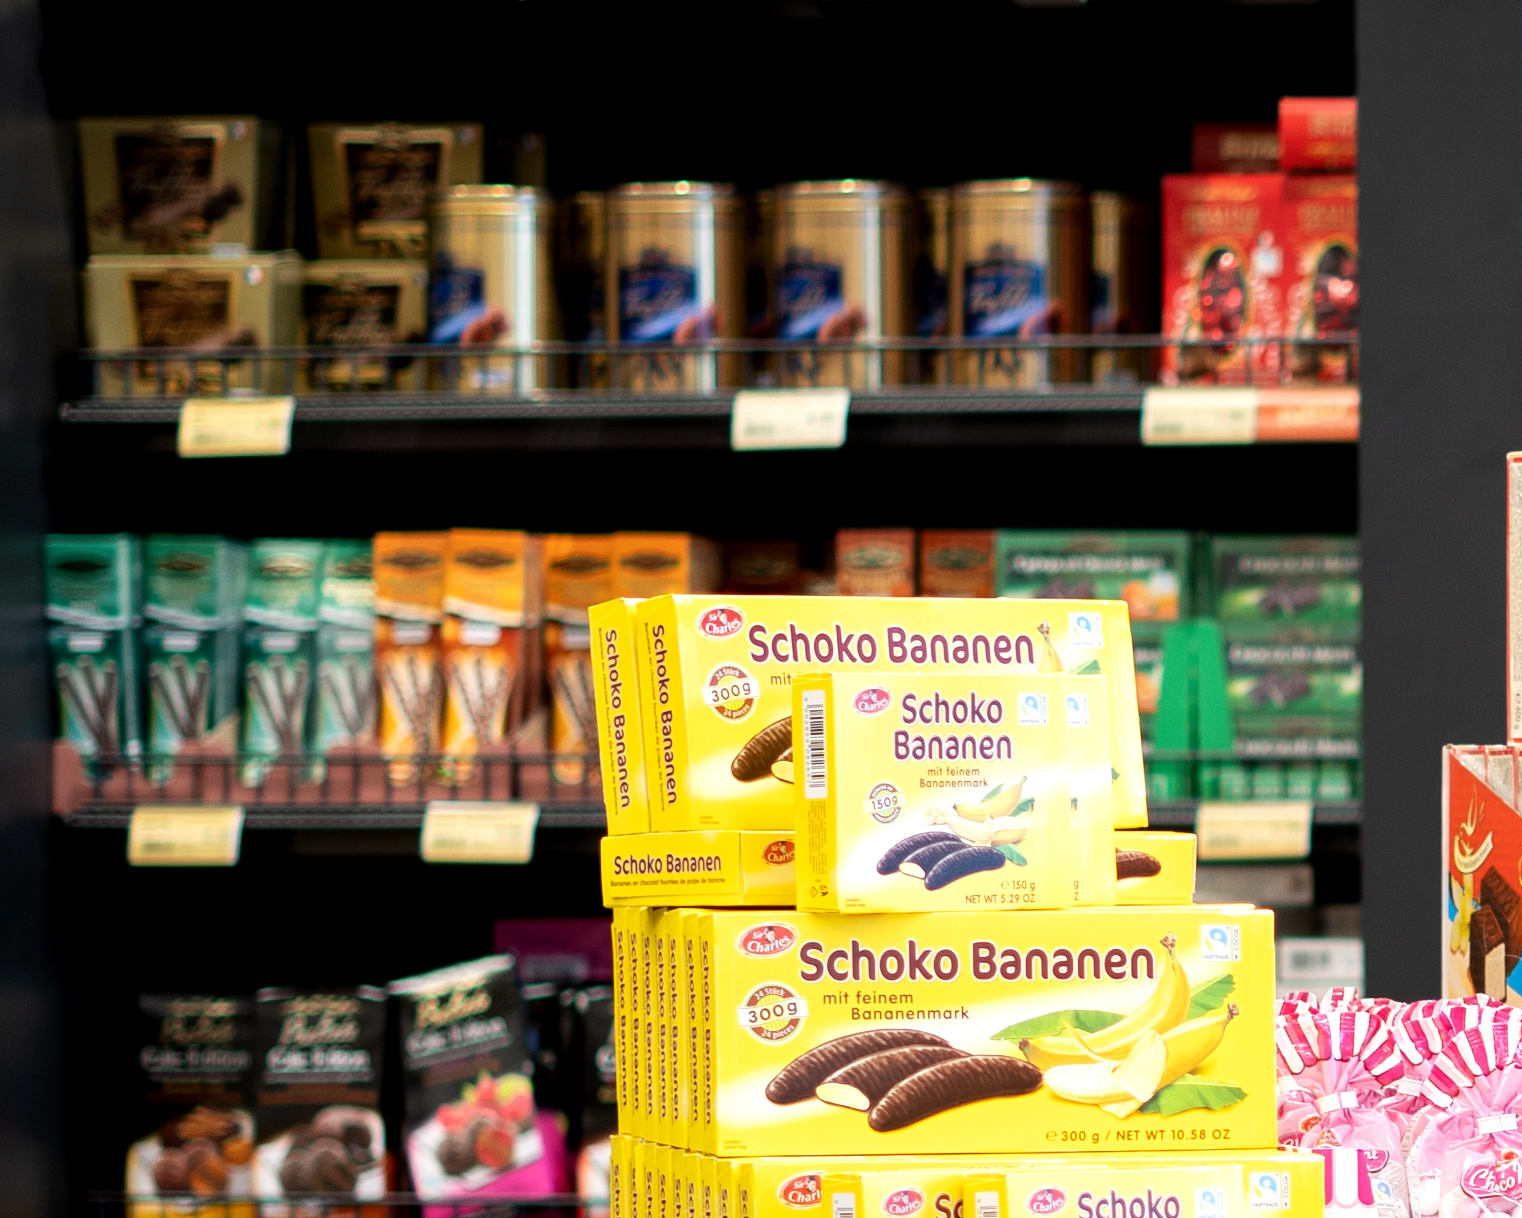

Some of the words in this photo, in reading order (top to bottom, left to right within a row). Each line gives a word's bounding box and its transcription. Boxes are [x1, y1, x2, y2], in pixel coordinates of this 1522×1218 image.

[705, 618, 742, 634] Charles
[749, 624, 878, 665] Schoko
[888, 626, 1035, 666] Bananen
[605, 629, 623, 709] Schoko
[771, 674, 792, 686] mit
[652, 624, 669, 704] Schoko
[661, 710, 677, 805] Bananen
[901, 692, 1003, 725] Schoko
[894, 729, 1013, 761] Bananen
[613, 715, 630, 808] Bananen
[927, 767, 943, 777] mit
[945, 766, 980, 777] feinem
[919, 779, 989, 789] Bananenmark
[614, 854, 663, 875] Schoko
[666, 853, 722, 873] Bananen
[1012, 879, 1027, 891] 150
[965, 894, 983, 905] NET
[984, 894, 998, 905] WT
[1000, 893, 1021, 905] 5.29
[1022, 893, 1036, 904] OZ
[747, 935, 791, 954] Charles
[800, 939, 959, 982] Schoko
[972, 941, 1154, 981] Bananen
[617, 931, 625, 1009] Schoko
[702, 940, 710, 1022] Schoko
[754, 989, 764, 999] 24
[764, 985, 787, 998] Stück
[823, 991, 850, 1005] mit
[855, 991, 914, 1005] feinem
[851, 1006, 970, 1021] Bananenmark
[761, 1028, 772, 1039] 24
[771, 1024, 796, 1040] pieces
[1061, 1130, 1088, 1143] 300
[1091, 1132, 1100, 1145] g
[1116, 1129, 1141, 1142] NET
[1145, 1128, 1166, 1141] WT
[1170, 1128, 1207, 1142] 10.58
[1211, 1128, 1231, 1140] OZ
[889, 1199, 920, 1214] Charles
